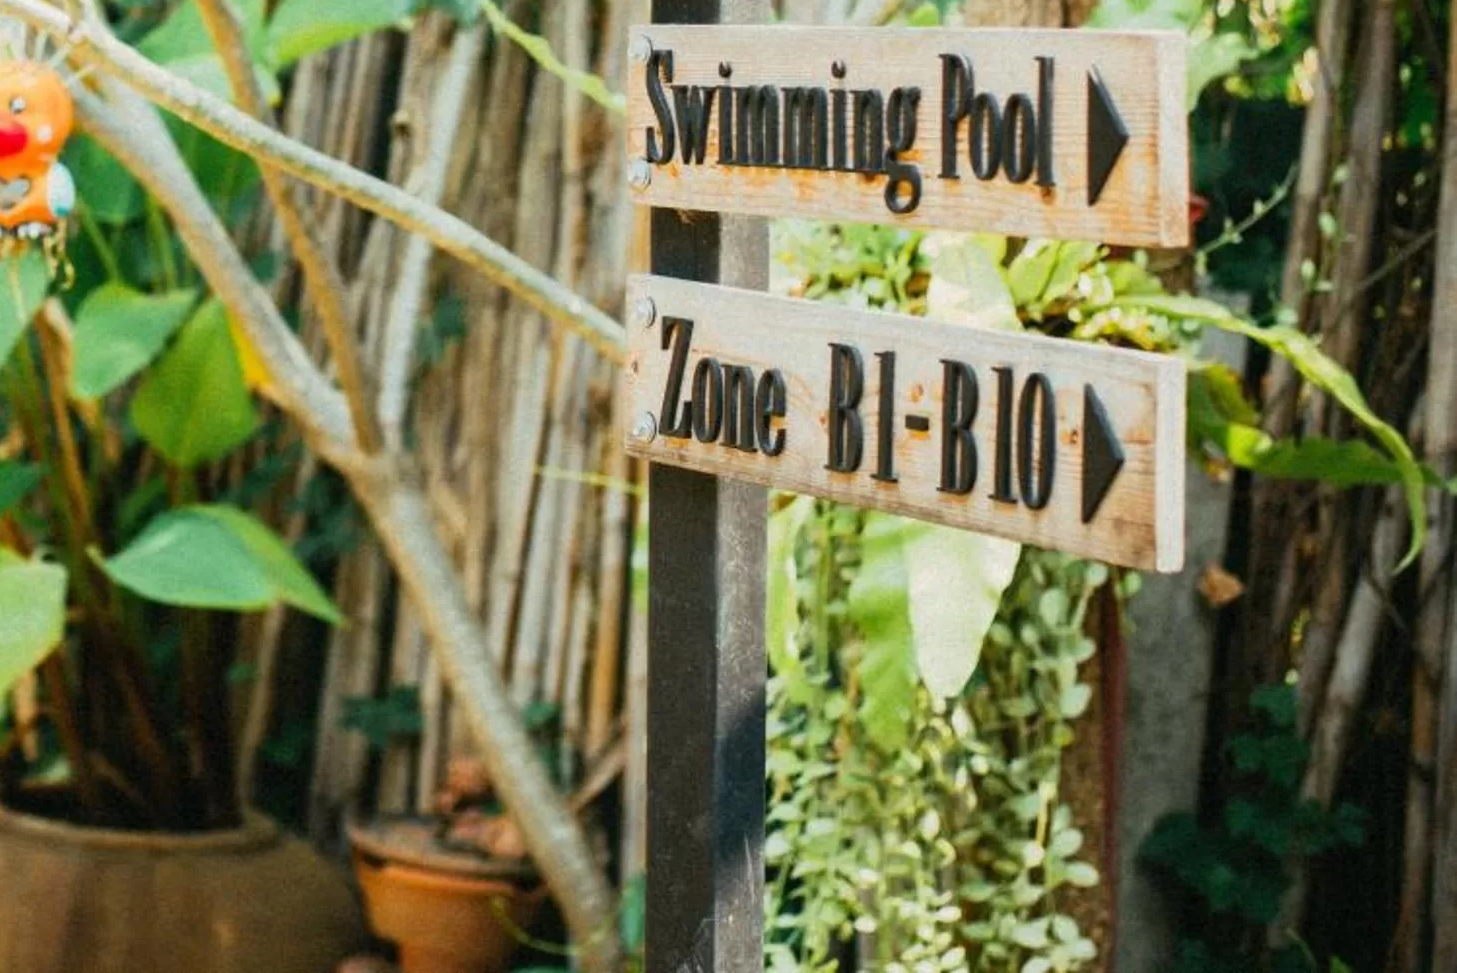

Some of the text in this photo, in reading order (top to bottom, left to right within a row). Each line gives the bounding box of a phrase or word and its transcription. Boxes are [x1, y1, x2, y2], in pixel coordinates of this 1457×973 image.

[646, 49, 1056, 214] Swimming Pool
[658, 316, 1057, 511] Zone B1-B10
